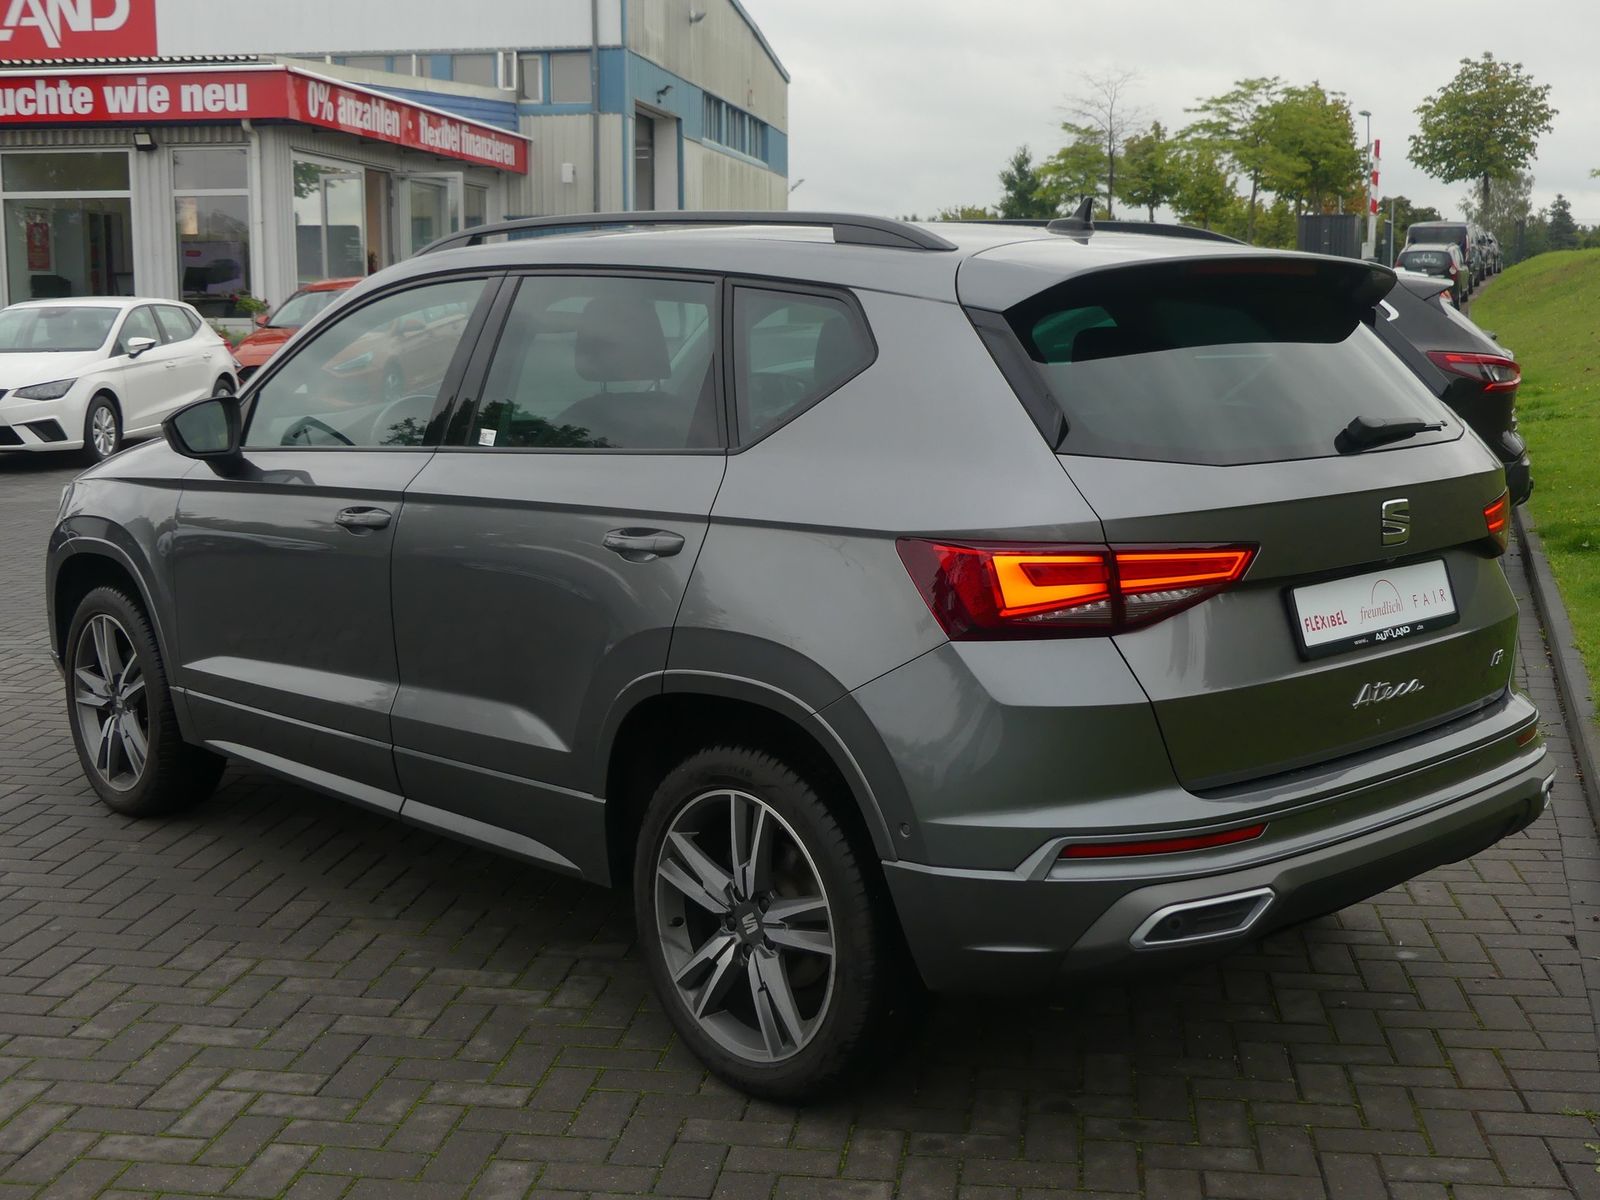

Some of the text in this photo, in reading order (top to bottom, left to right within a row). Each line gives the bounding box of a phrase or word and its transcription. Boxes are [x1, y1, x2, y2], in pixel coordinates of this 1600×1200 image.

[103, 77, 170, 114] wie
[180, 83, 248, 113] neu
[307, 80, 515, 166] 0% anzahlen flexibel finanzieren
[1304, 588, 1447, 633] FLEXIBEL freundlich FAIR
[1375, 625, 1410, 641] AUTOLAND
